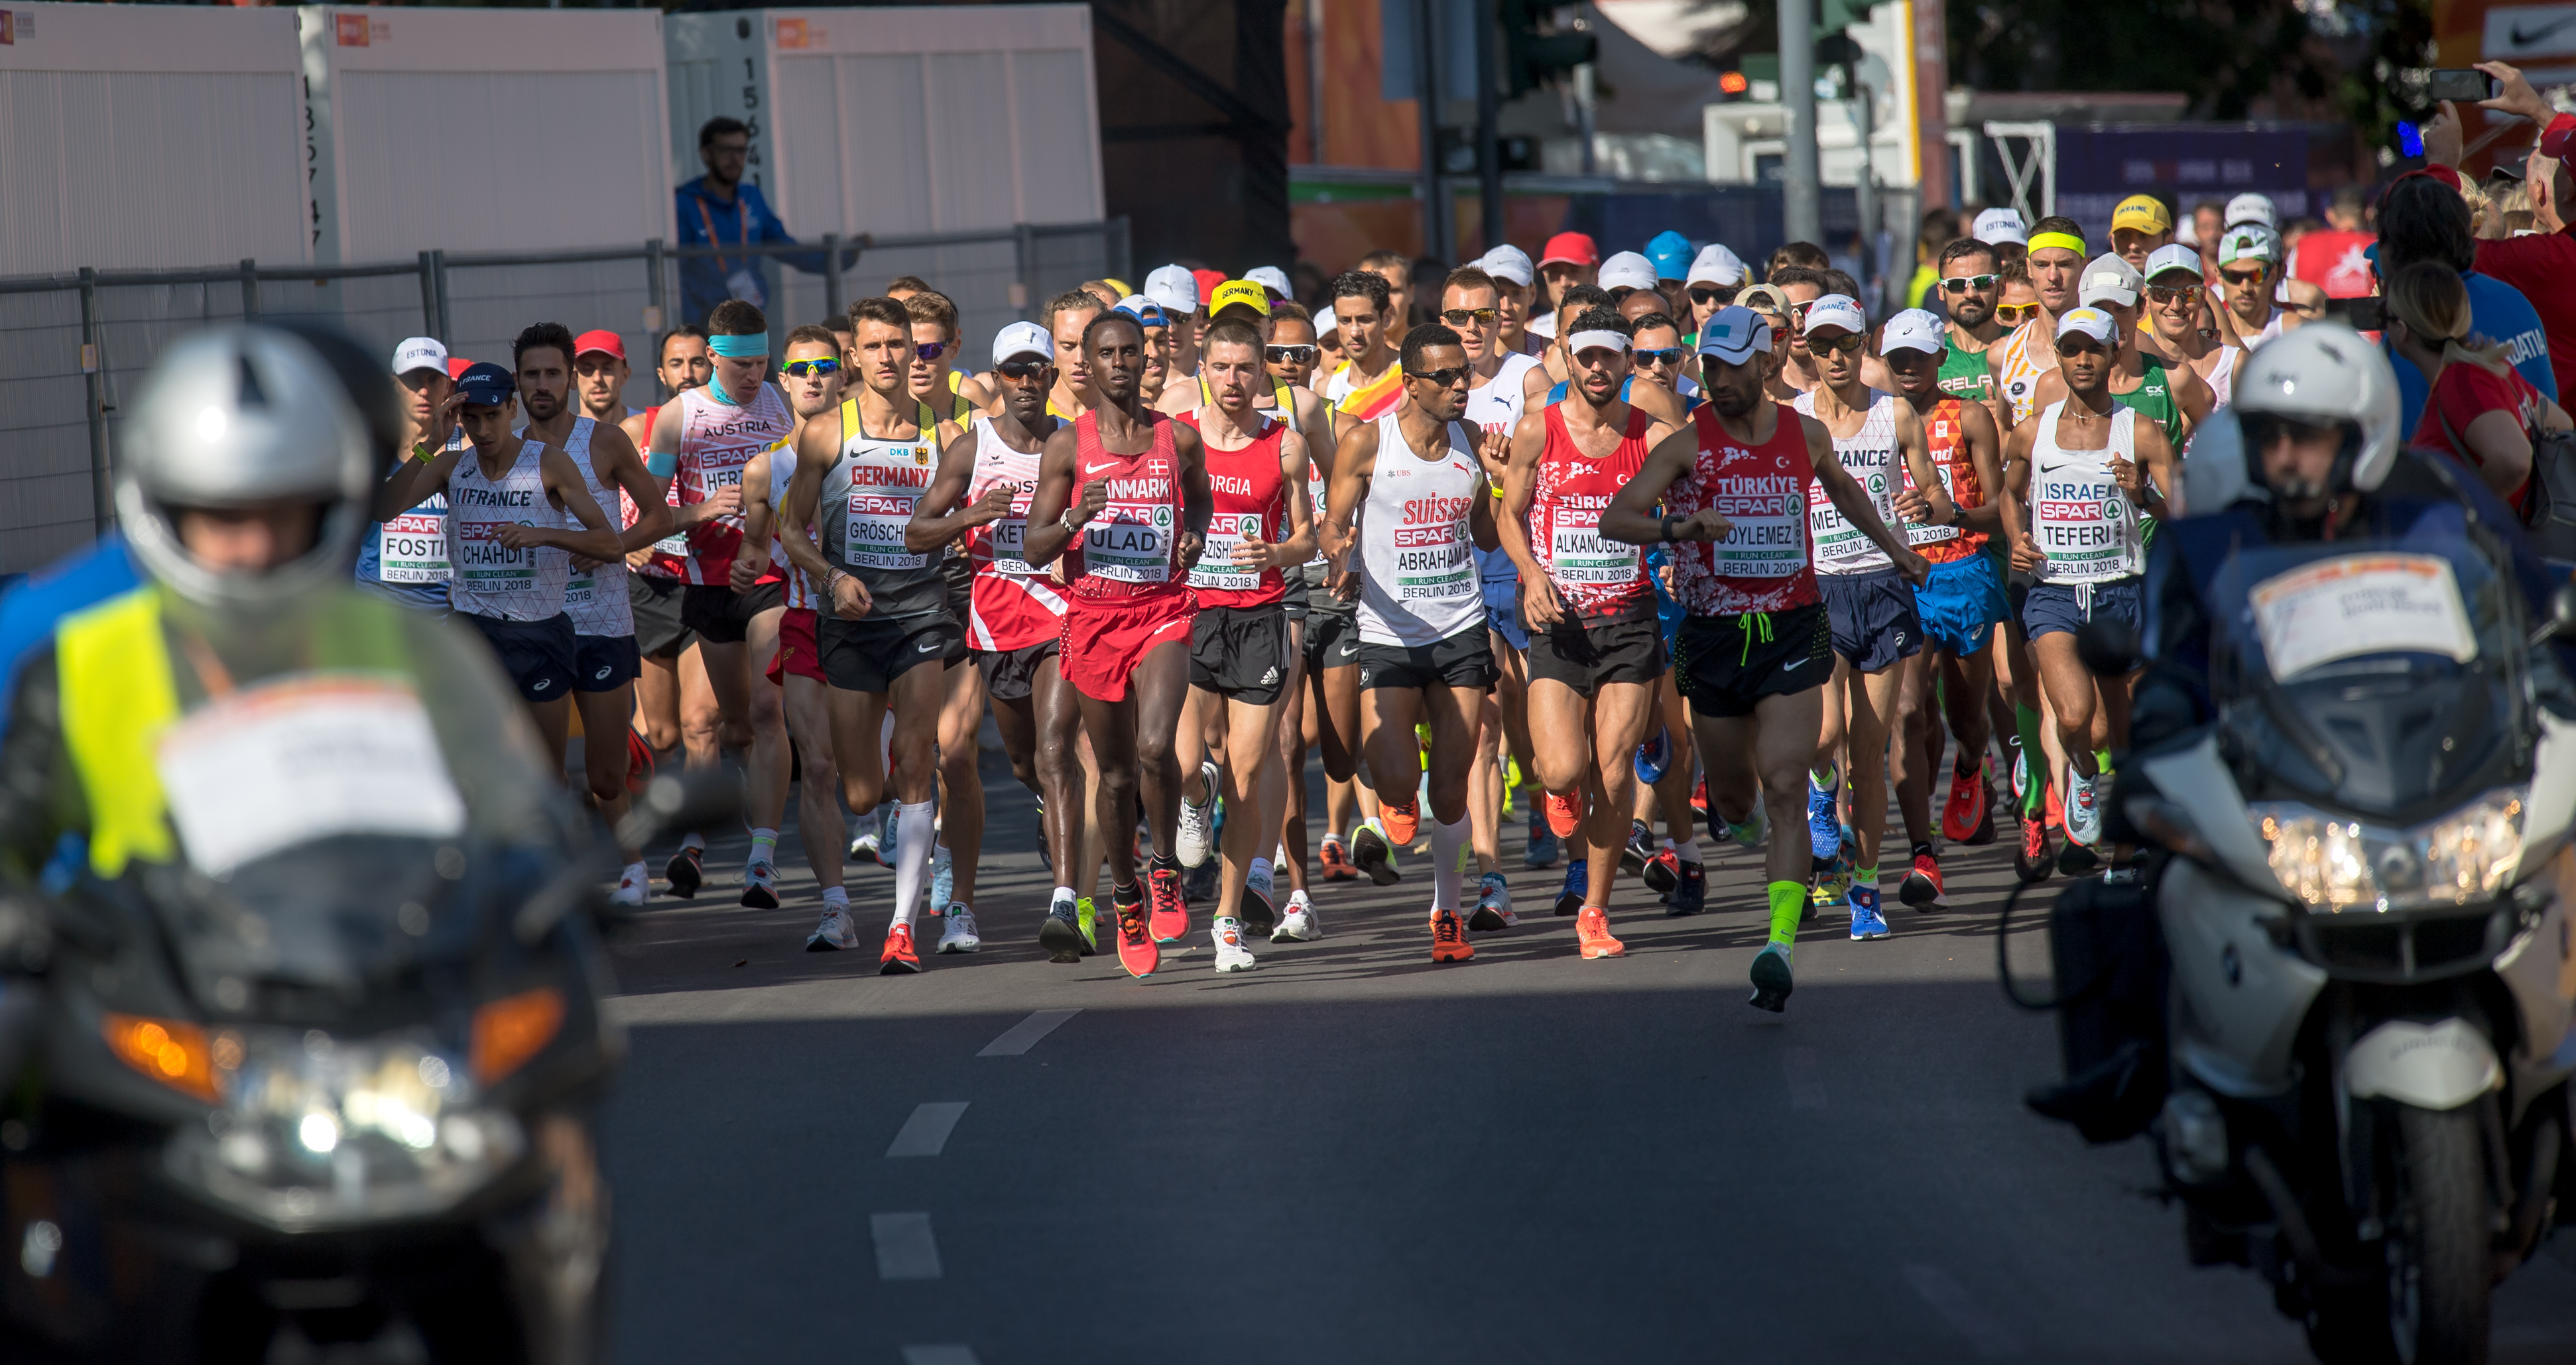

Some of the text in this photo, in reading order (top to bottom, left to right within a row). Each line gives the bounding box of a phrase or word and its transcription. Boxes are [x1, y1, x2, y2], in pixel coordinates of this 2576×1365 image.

[1222, 288, 1253, 299] GERMANY
[1817, 303, 1846, 313] FRANCE
[406, 348, 438, 359] ESTONIA
[462, 375, 491, 386] FRANCE
[704, 420, 772, 439] AUSTRIA
[851, 465, 930, 488] GERMANY
[1718, 473, 1799, 495] TÜRKİYE
[467, 489, 532, 506] FRANCE
[2045, 483, 2118, 499] ISRAEL
[851, 498, 911, 513] SPAR
[1718, 499, 1783, 514] SPAR
[2042, 504, 2100, 519] SPAR
[384, 518, 439, 532] SPAR
[1089, 528, 1156, 552] ULAD
[1396, 527, 1454, 545] SPAR
[1834, 532, 1851, 542] RUN
[1923, 528, 1951, 542] 2018
[2044, 525, 2110, 546] TEFERI
[387, 538, 444, 556] FOSTI
[1822, 542, 1863, 558] BERLIN
[463, 546, 522, 564] CHAHDI
[854, 554, 922, 567] BERLIN 2018
[1398, 547, 1462, 571] ABRAHAM
[1092, 563, 1162, 579] BERLIN 2018
[1724, 562, 1800, 575] BERLIN 2018
[2049, 559, 2119, 573] BERLIN 2018
[387, 569, 449, 580] BERLIN 2018
[1224, 577, 1251, 587] 2018
[1562, 569, 1632, 581] BERLIN 2018
[467, 579, 532, 591] BERLIN 2018
[1403, 581, 1471, 598] BERLIN 2018
[565, 591, 591, 603] 2018
